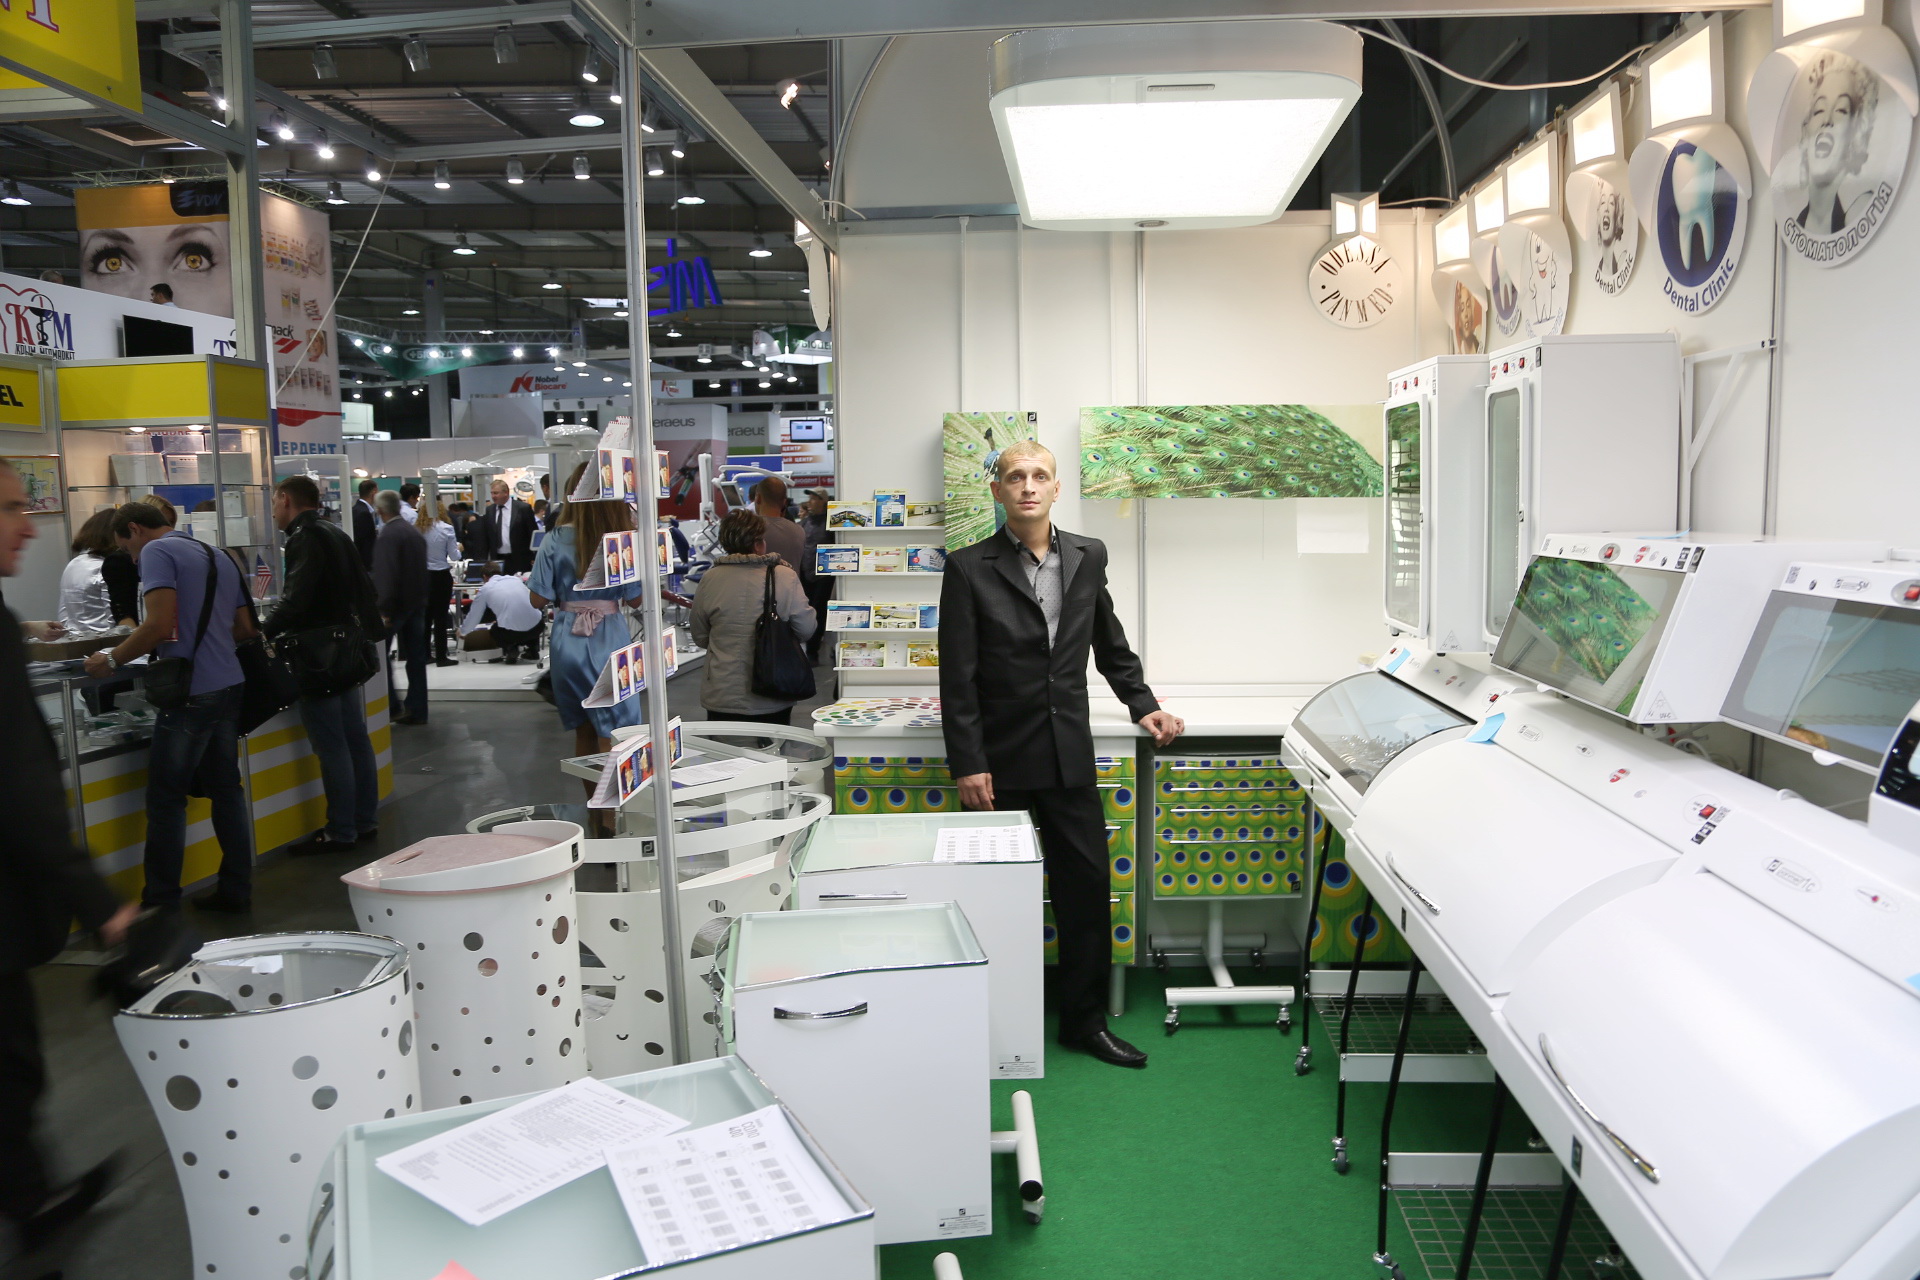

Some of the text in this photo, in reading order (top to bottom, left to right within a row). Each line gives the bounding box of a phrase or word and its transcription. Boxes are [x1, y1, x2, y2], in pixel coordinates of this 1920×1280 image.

[1783, 181, 1893, 261] СТОМАТОЛОГІЯ
[1319, 242, 1392, 276] ODESSA
[1594, 253, 1634, 295] Dental Clinic
[1663, 257, 1735, 312] Dental Clinic
[535, 382, 567, 390] Biocare
